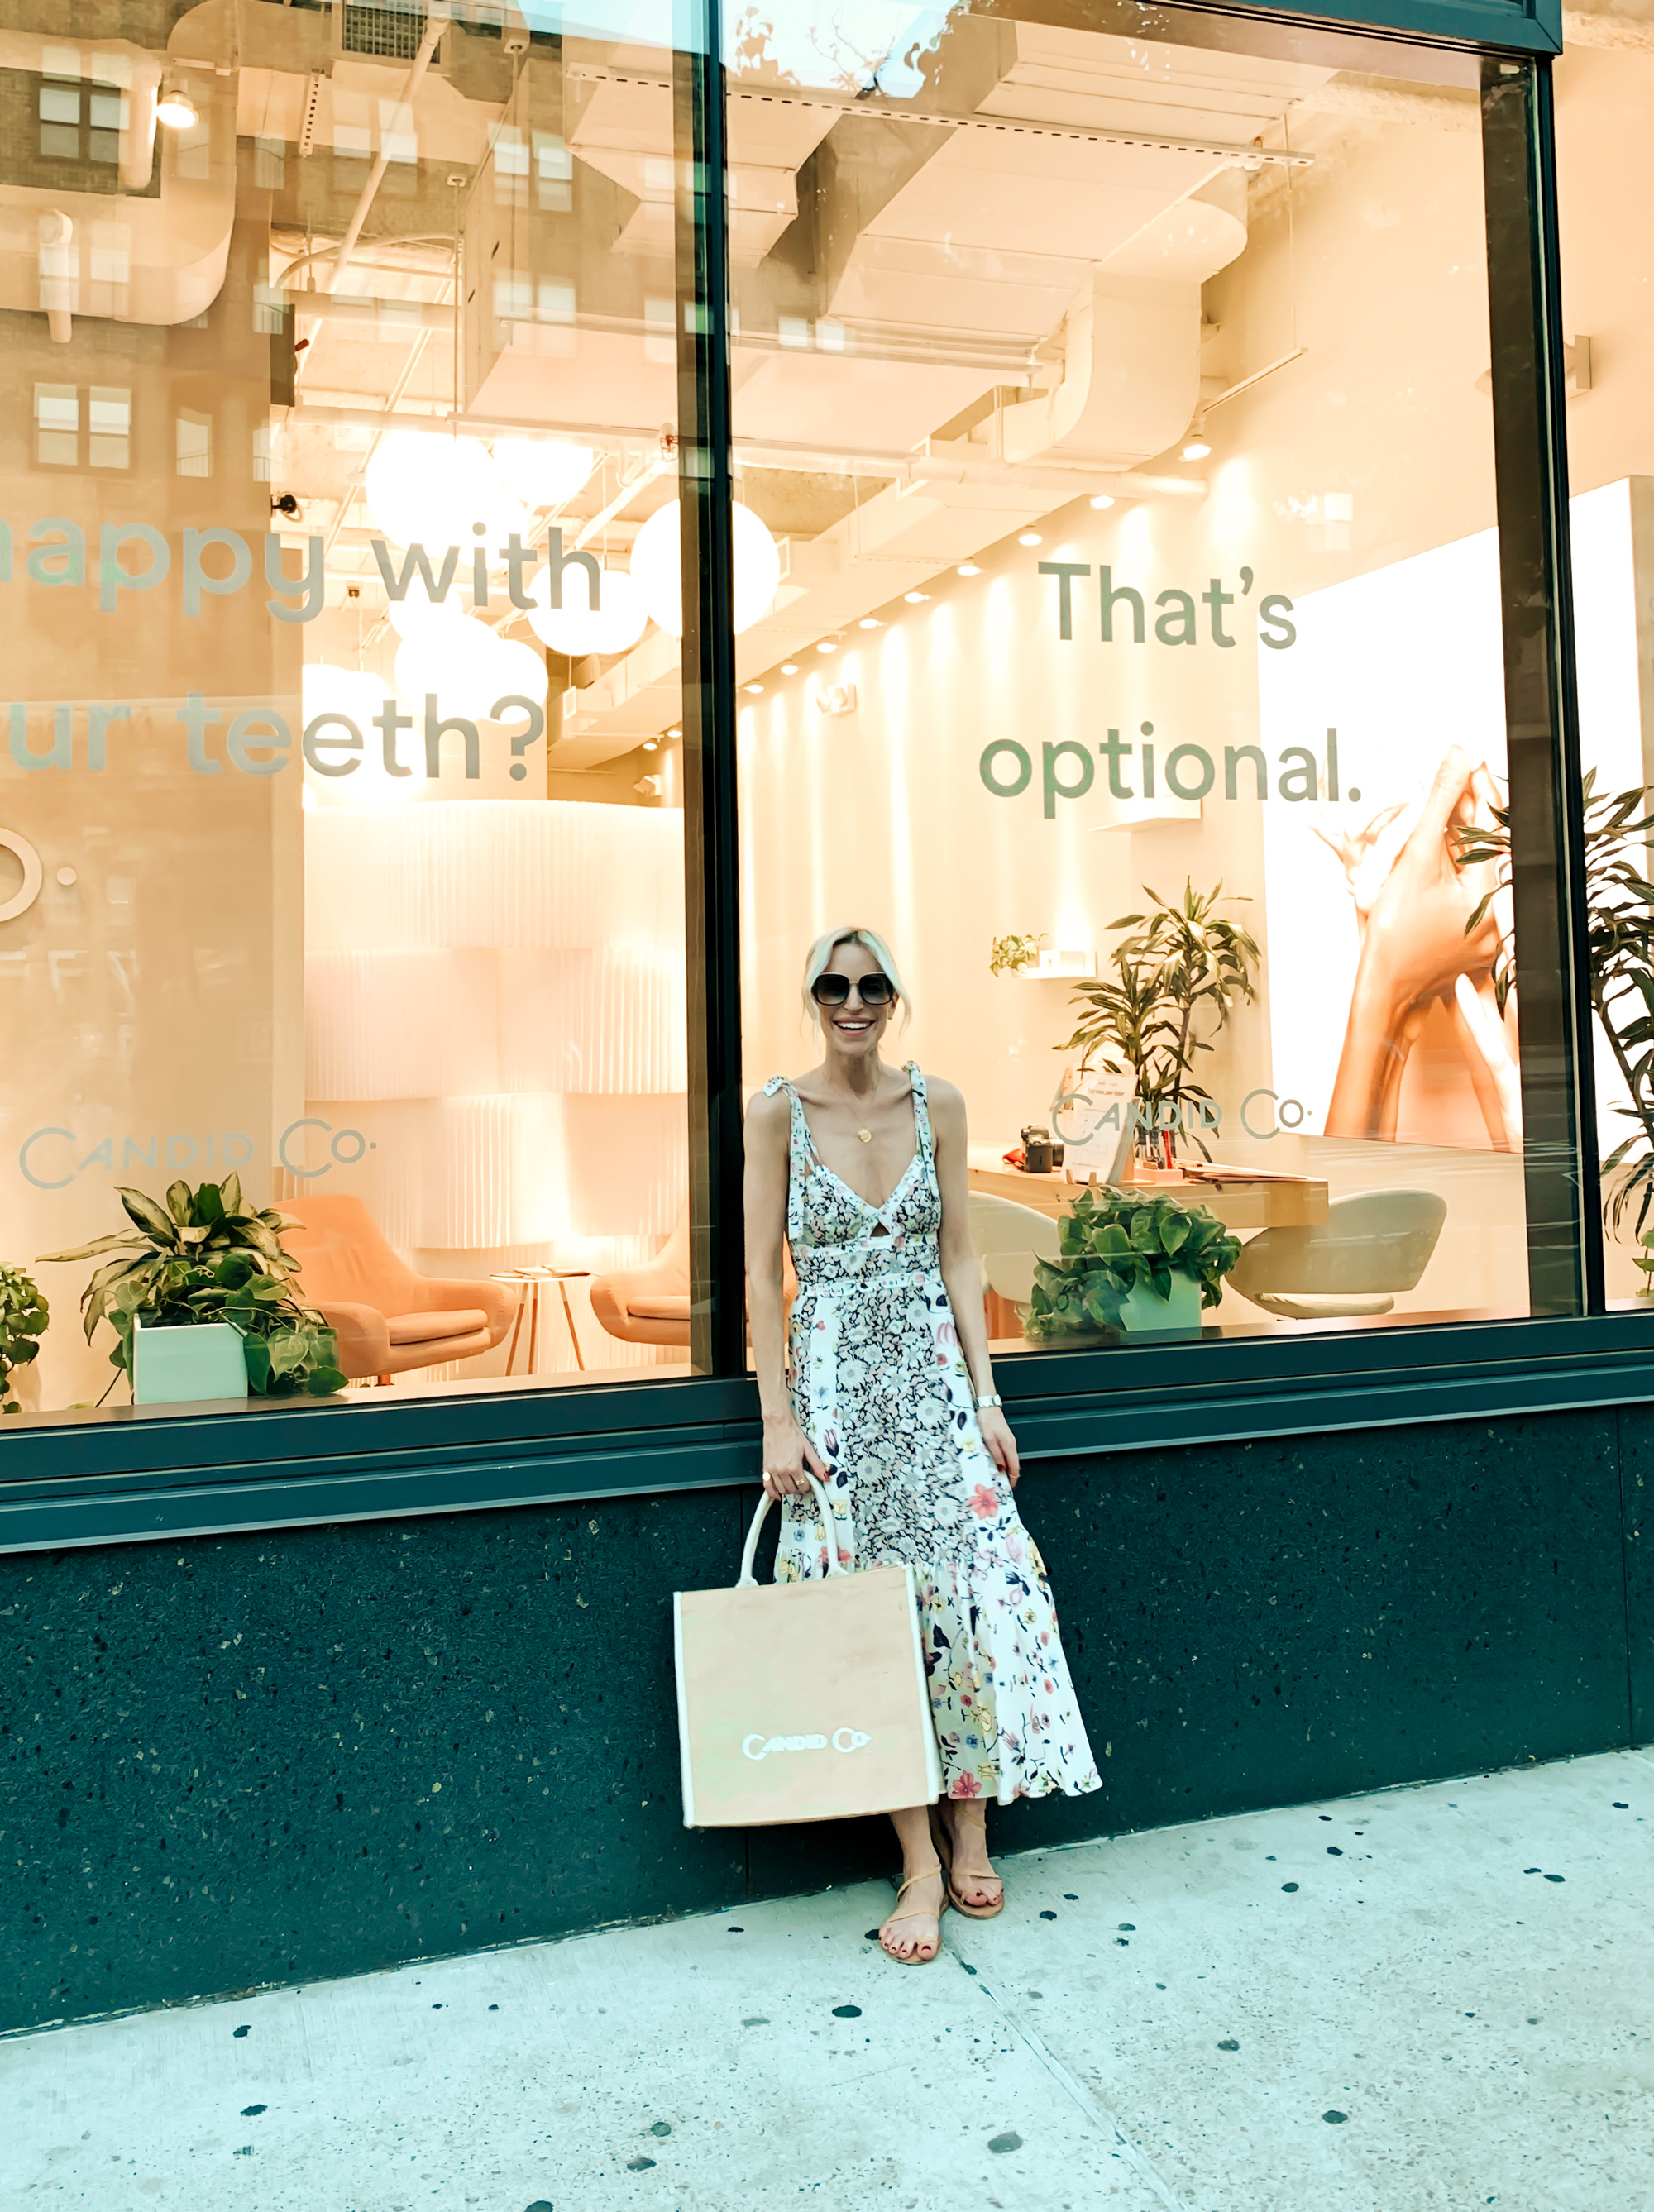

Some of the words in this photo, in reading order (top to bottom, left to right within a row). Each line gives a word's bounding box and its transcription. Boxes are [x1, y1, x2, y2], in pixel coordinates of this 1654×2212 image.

[0, 517, 324, 623] appy
[371, 521, 602, 611] with
[1038, 561, 1297, 650] That’s
[176, 690, 545, 781] teeth?
[979, 721, 1361, 819] optional.
[19, 1127, 255, 1190] CANDID
[1052, 1094, 1223, 1146] CANDID
